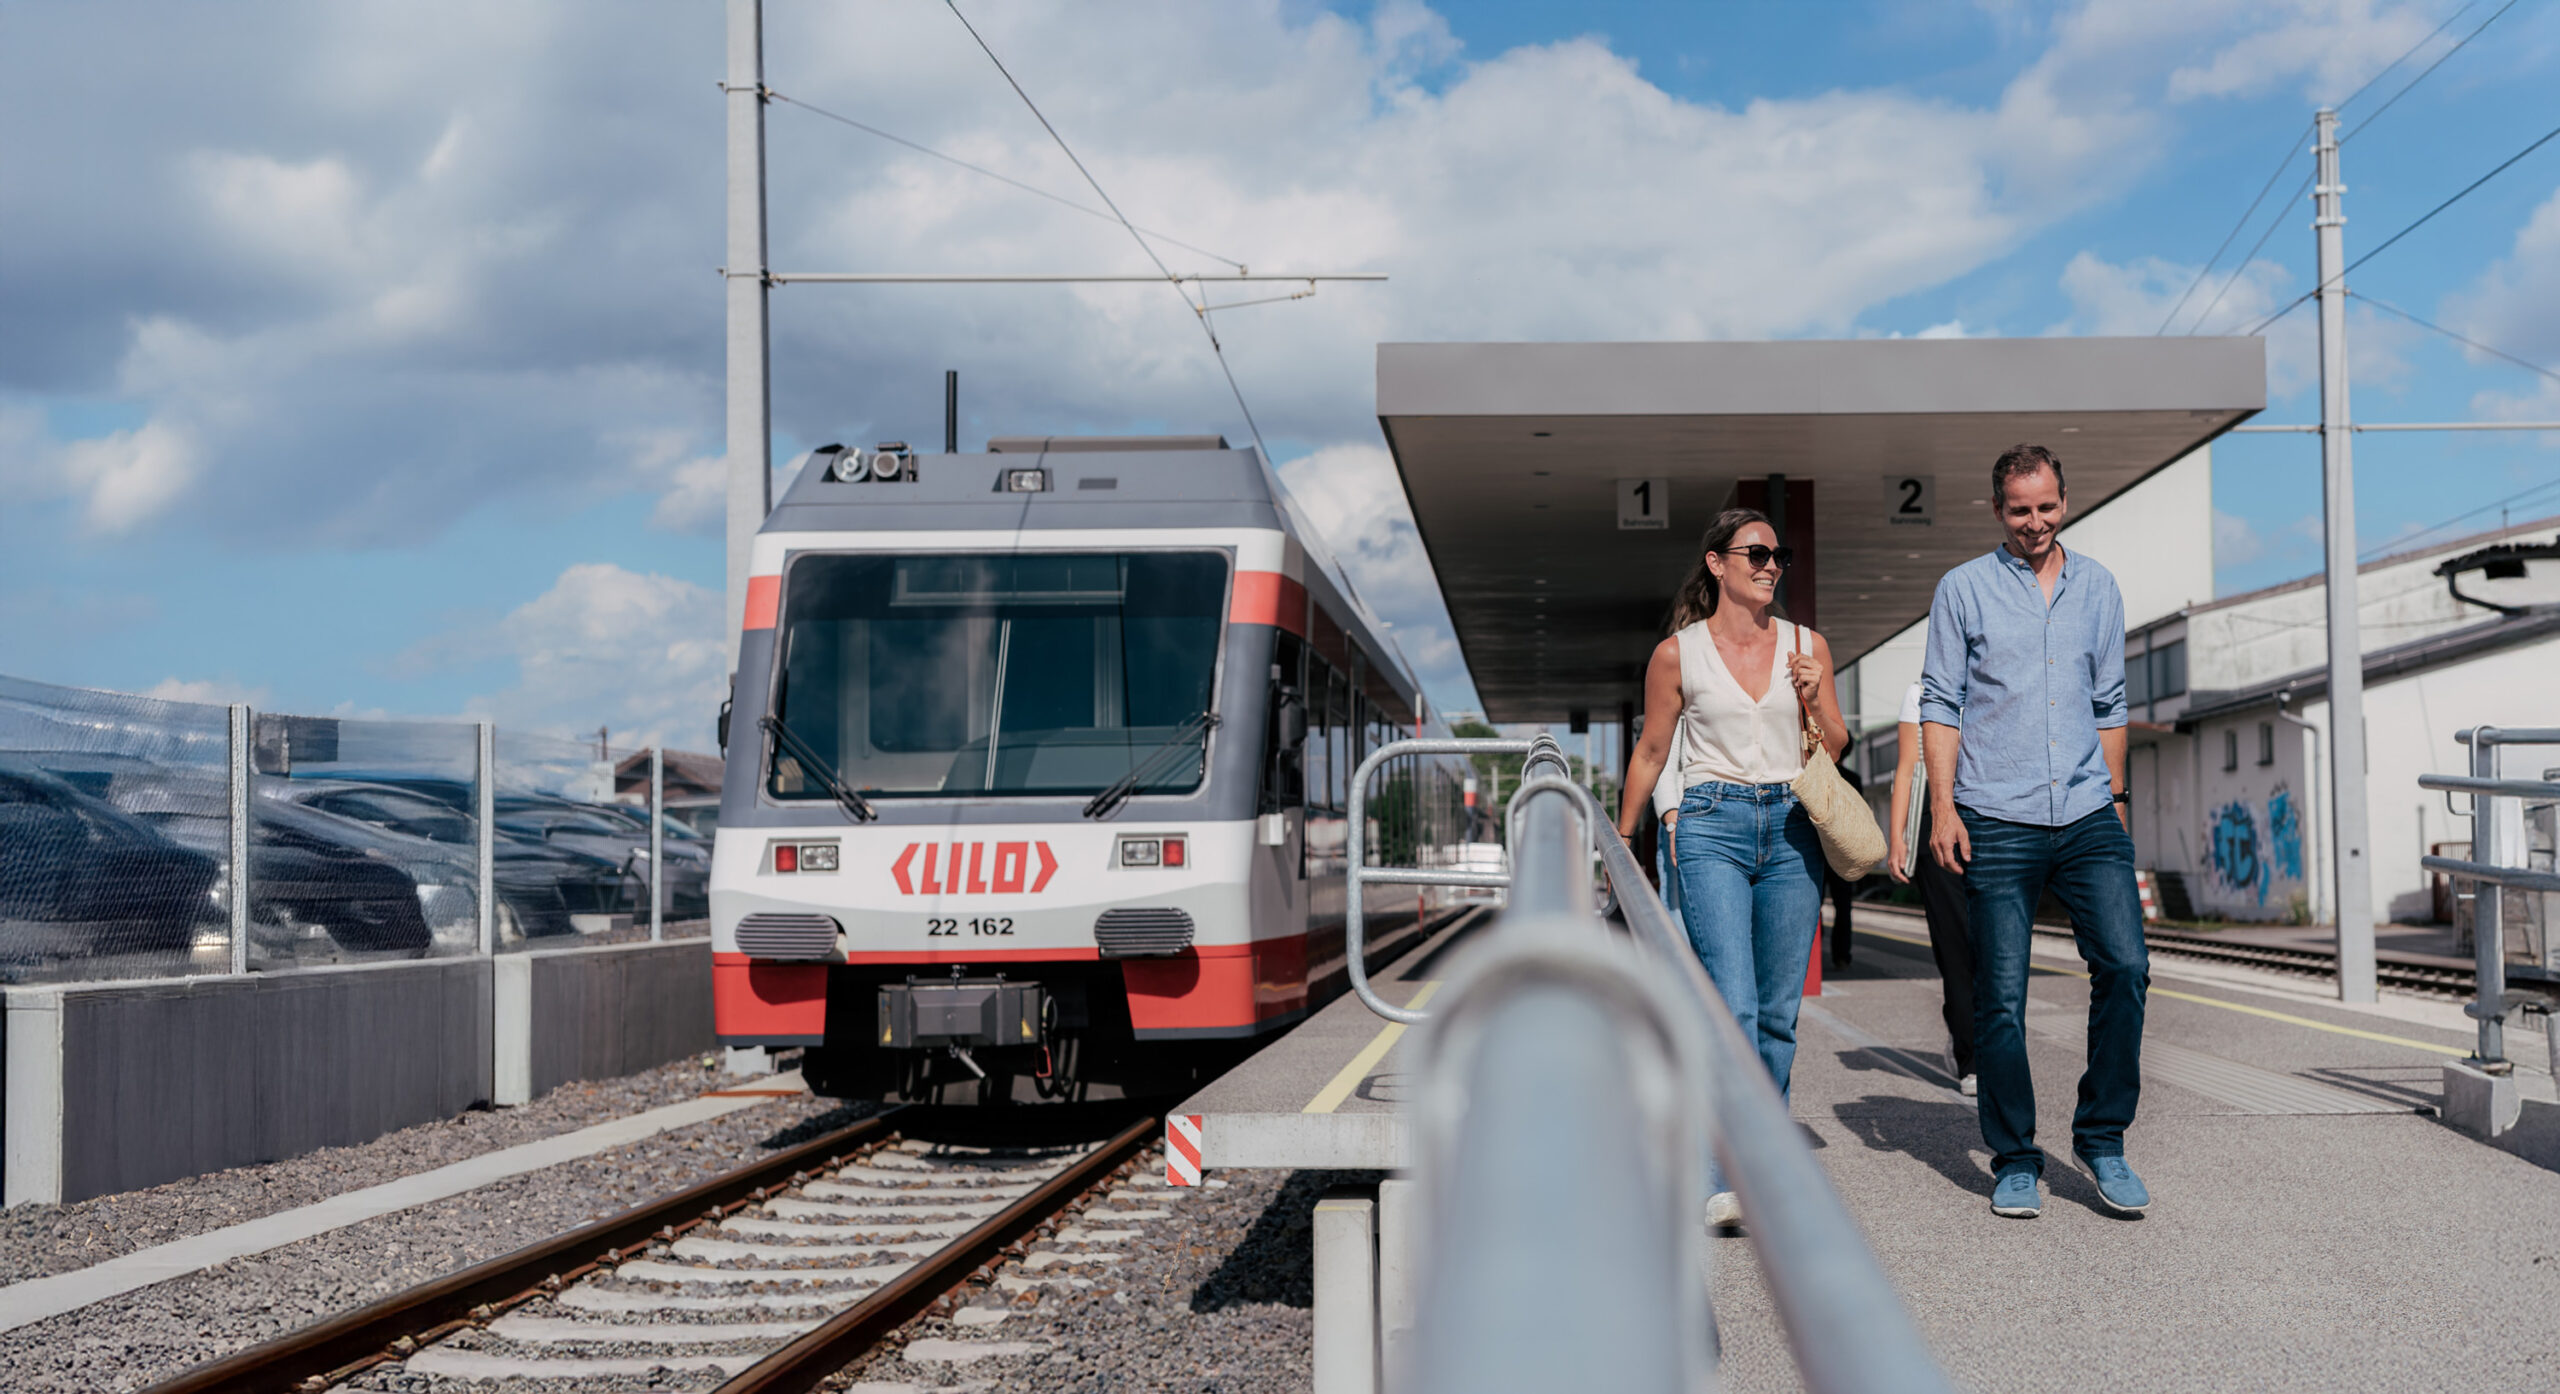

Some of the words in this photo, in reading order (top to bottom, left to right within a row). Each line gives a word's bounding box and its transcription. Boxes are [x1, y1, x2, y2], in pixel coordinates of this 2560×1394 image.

[1633, 480, 1650, 516] 1
[1899, 478, 1922, 514] 2
[920, 841, 1029, 895] LILO
[928, 918, 958, 936] 22
[968, 917, 1014, 936] 162
